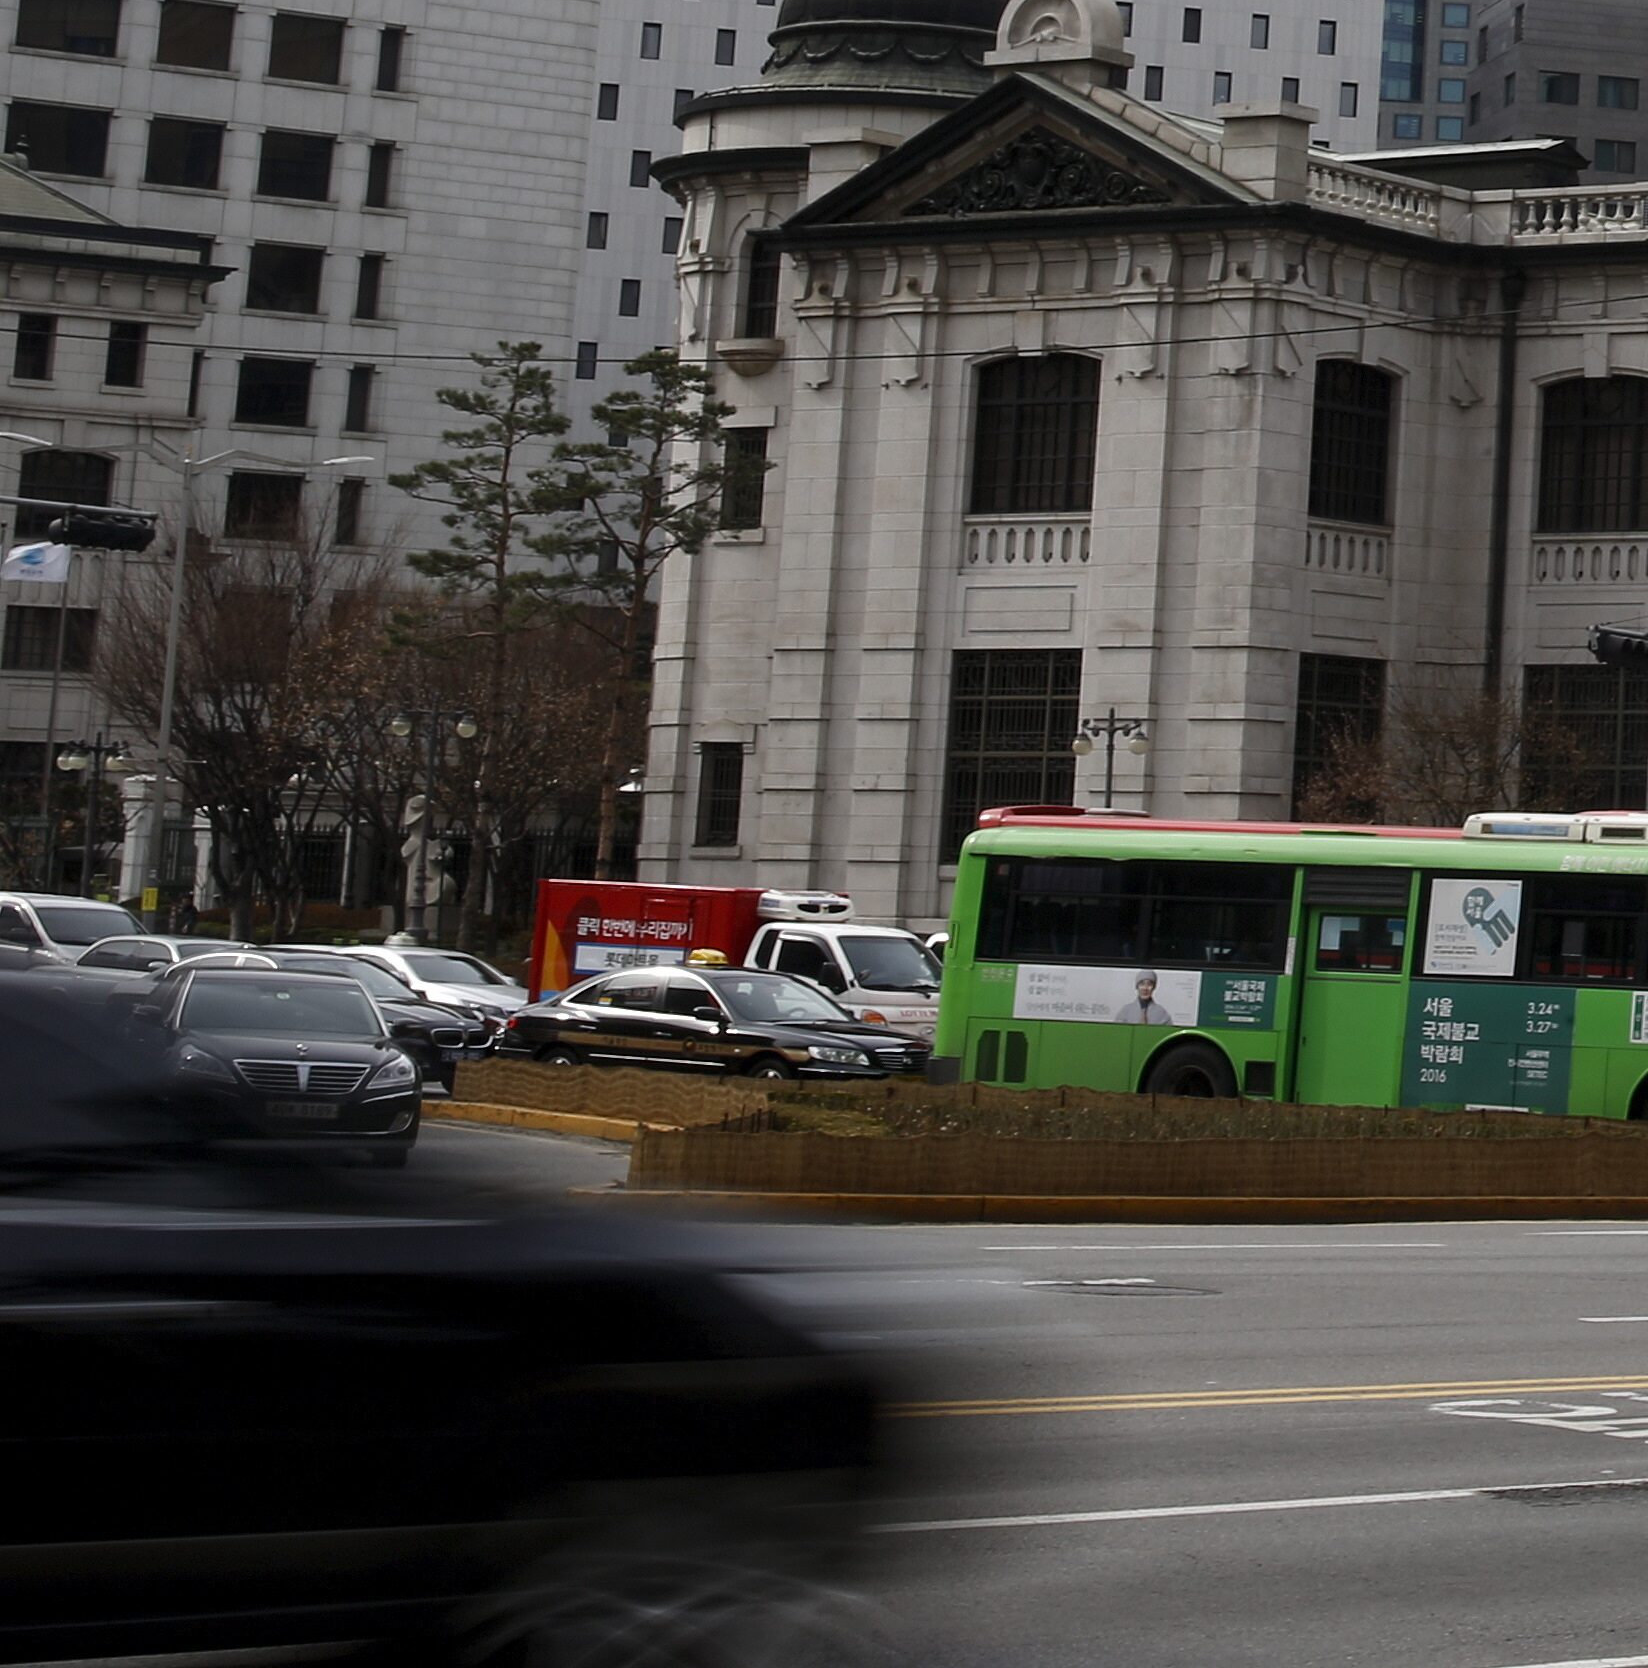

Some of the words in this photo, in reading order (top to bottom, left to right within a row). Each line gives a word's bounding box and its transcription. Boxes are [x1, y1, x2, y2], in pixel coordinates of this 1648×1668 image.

[577, 917, 600, 936] 클릭
[1423, 997, 1453, 1017] 서울
[1422, 1020, 1480, 1042] 국제불교
[1526, 1021, 1551, 1033] 3.27
[1420, 1044, 1464, 1064] 박람회
[1419, 1068, 1447, 1083] 2016
